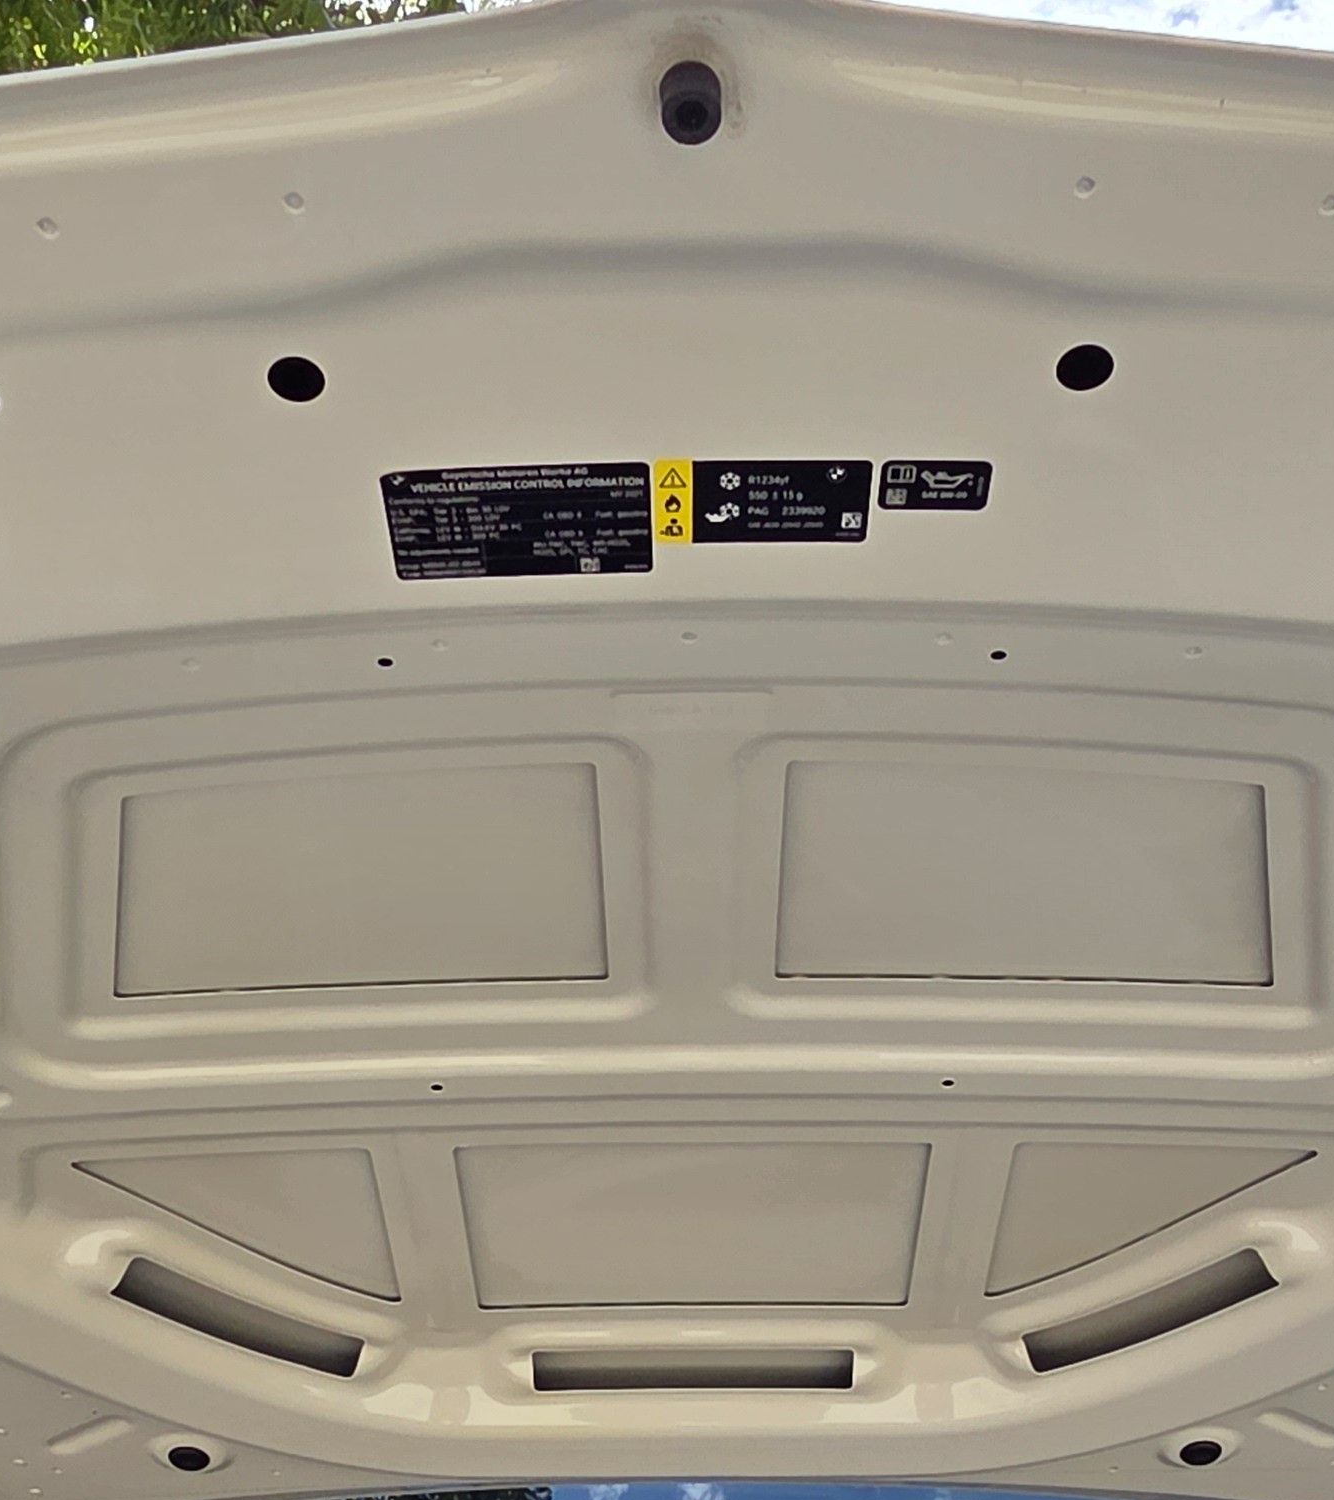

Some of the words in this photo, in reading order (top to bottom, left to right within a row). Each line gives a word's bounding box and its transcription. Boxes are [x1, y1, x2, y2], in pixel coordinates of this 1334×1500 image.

[409, 481, 457, 494] VEHICLE
[457, 479, 512, 492] EMISSION
[512, 478, 565, 490] CONTROL
[566, 476, 645, 489] INFORMATION
[747, 475, 790, 486] R1234yf
[747, 506, 770, 516] PAG
